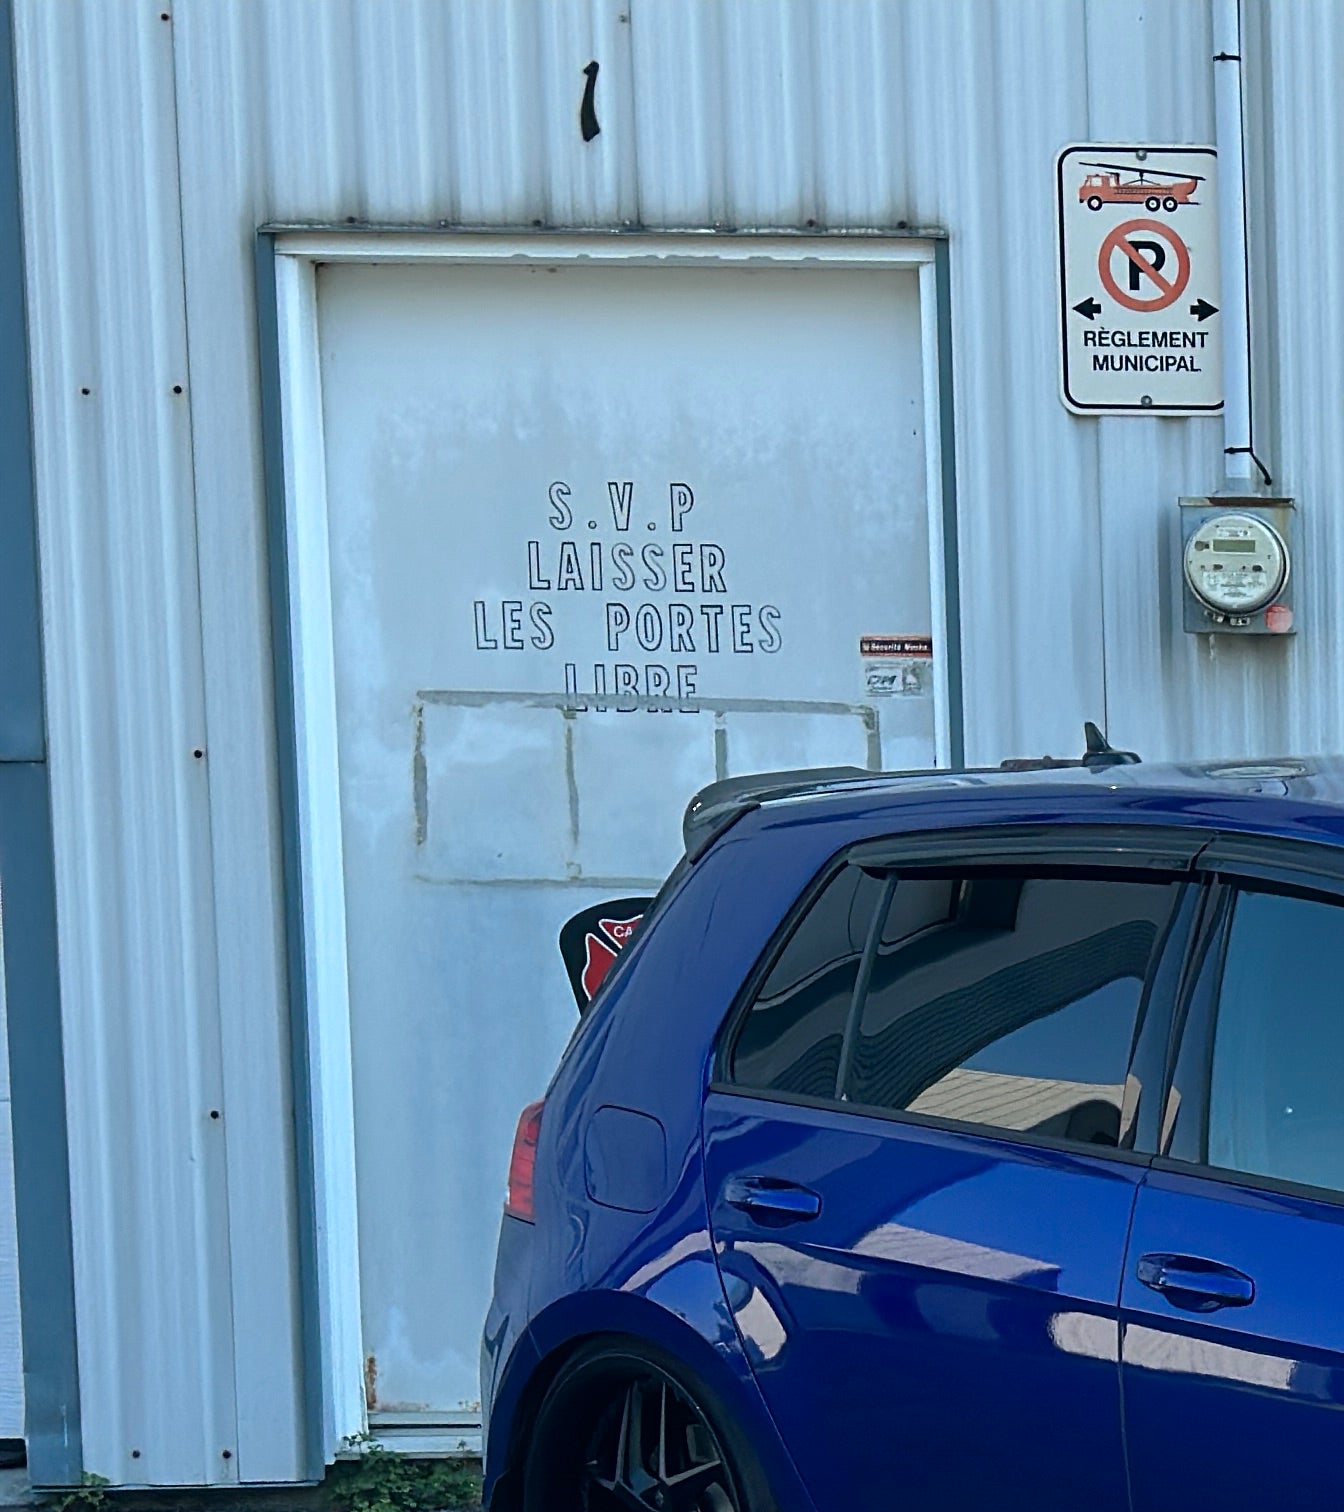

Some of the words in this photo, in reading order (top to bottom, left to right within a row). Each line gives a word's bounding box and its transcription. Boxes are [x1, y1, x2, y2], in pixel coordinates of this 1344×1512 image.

[580, 60, 601, 142] 1
[1127, 240, 1166, 291] P
[1083, 326, 1209, 348] RÈGLEMENT
[1092, 355, 1202, 373] MUNICIPAL
[527, 541, 727, 593] LAISSER
[474, 600, 555, 650] LES
[606, 602, 783, 654] PORTES
[564, 662, 701, 714] LIBRE
